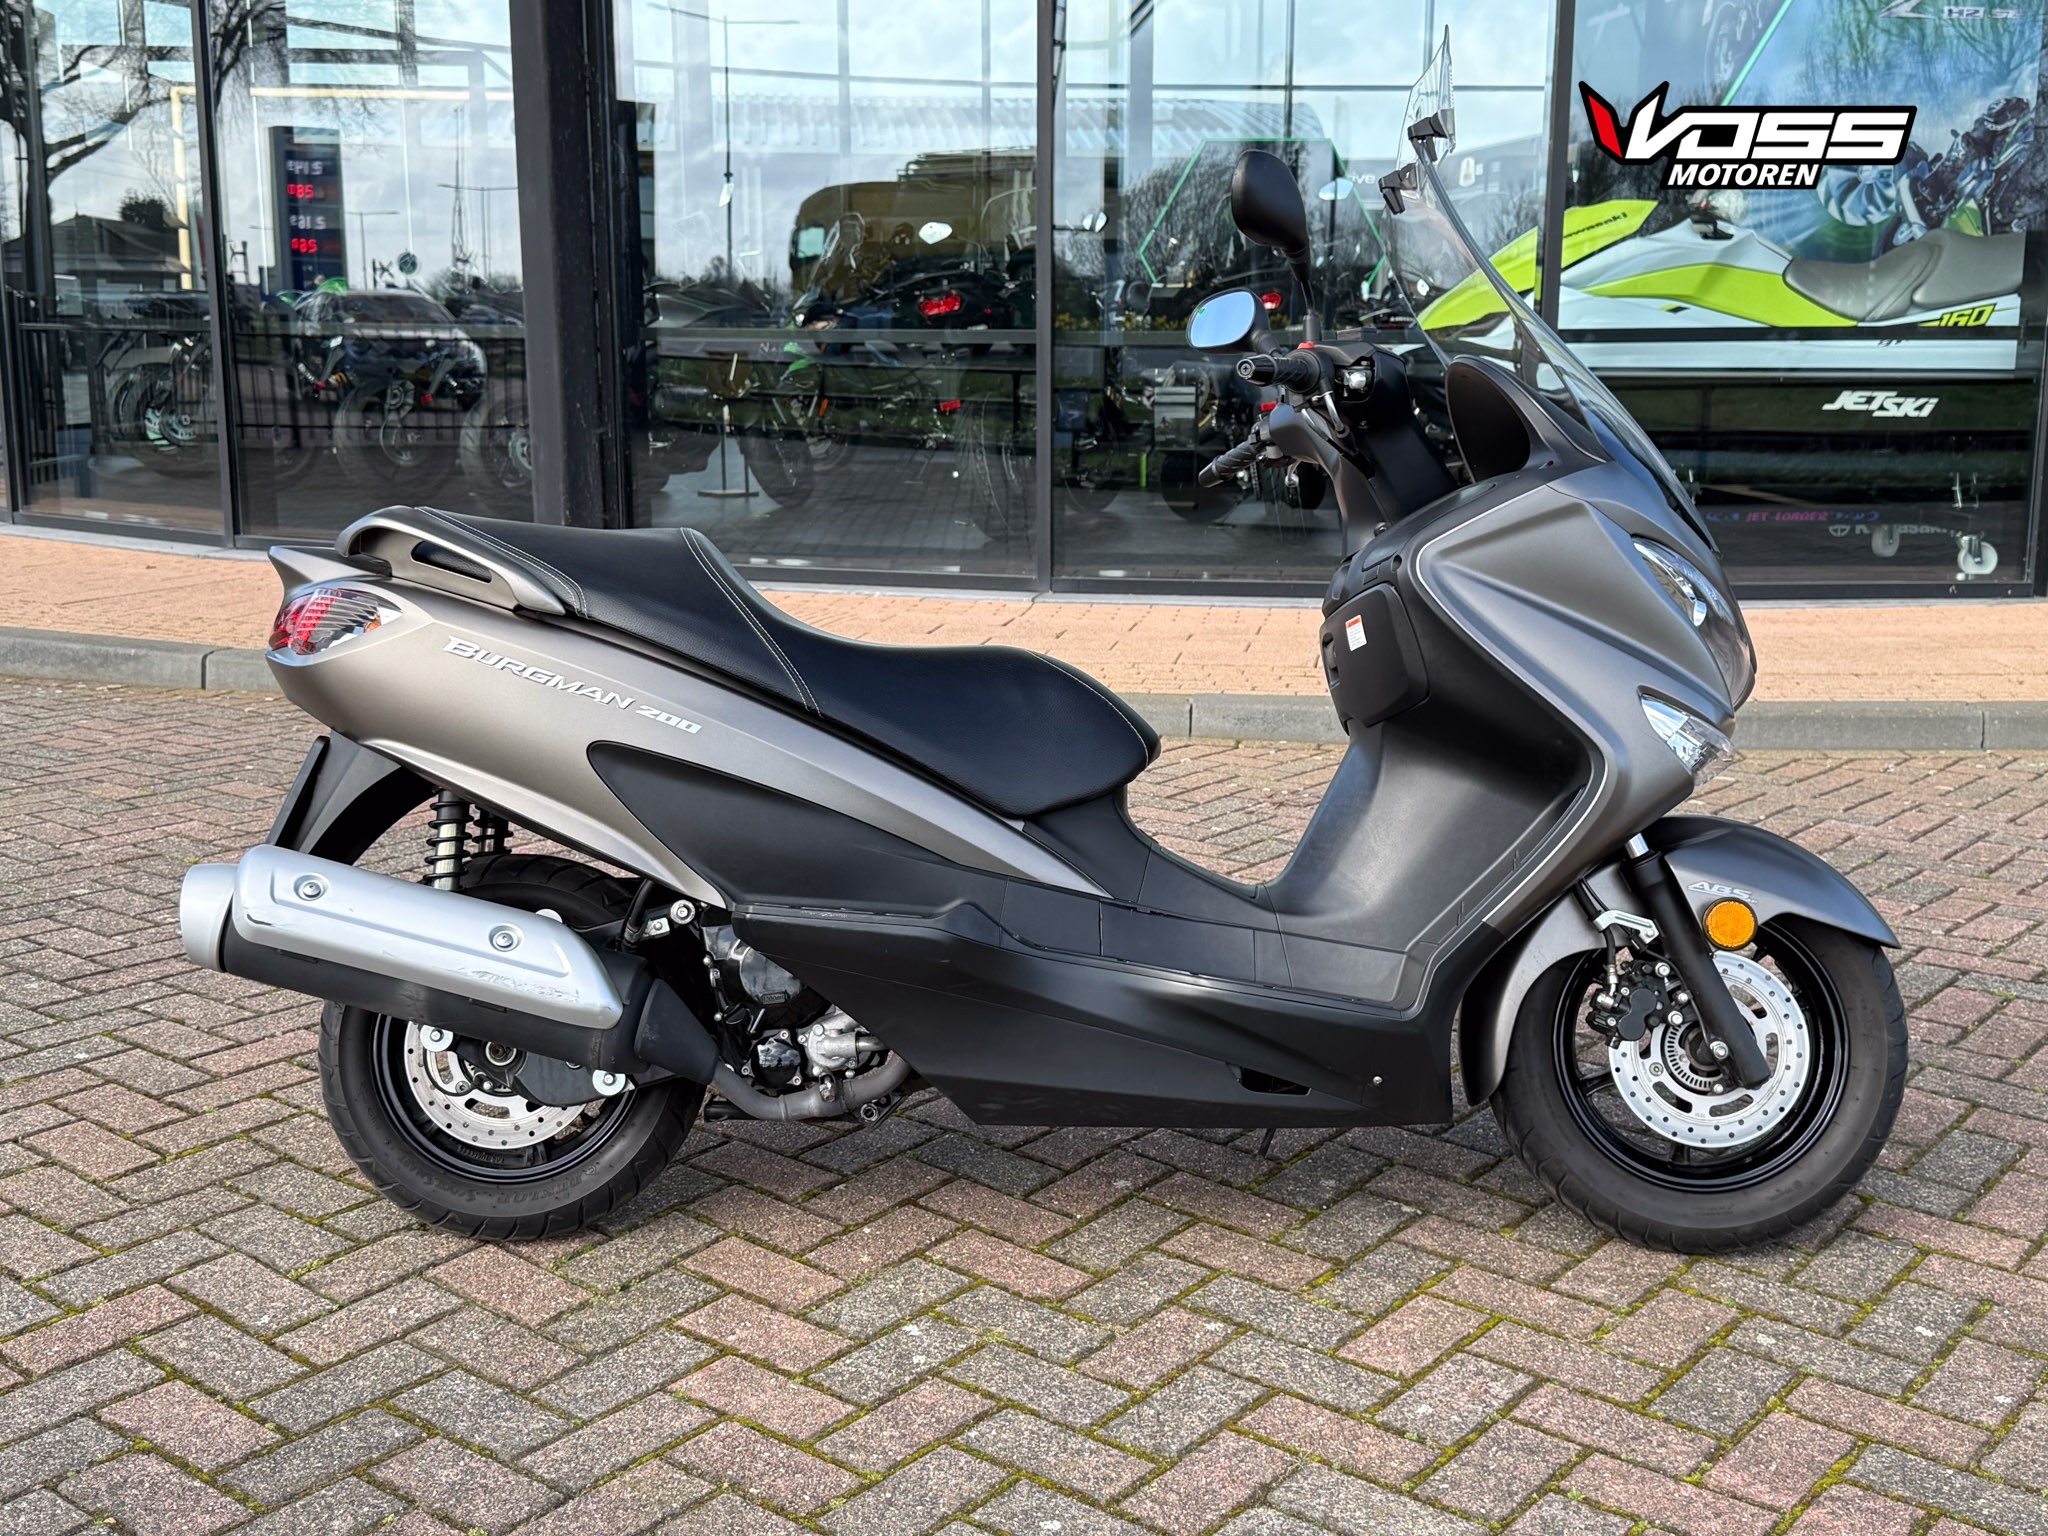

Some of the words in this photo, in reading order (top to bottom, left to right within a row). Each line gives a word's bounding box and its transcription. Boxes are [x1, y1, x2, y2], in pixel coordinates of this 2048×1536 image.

[1563, 211, 1628, 239] awasaki
[1940, 304, 1995, 327] 160
[442, 635, 635, 711] BURGMAN
[635, 705, 703, 735] 200
[1687, 881, 1752, 900] ABS
